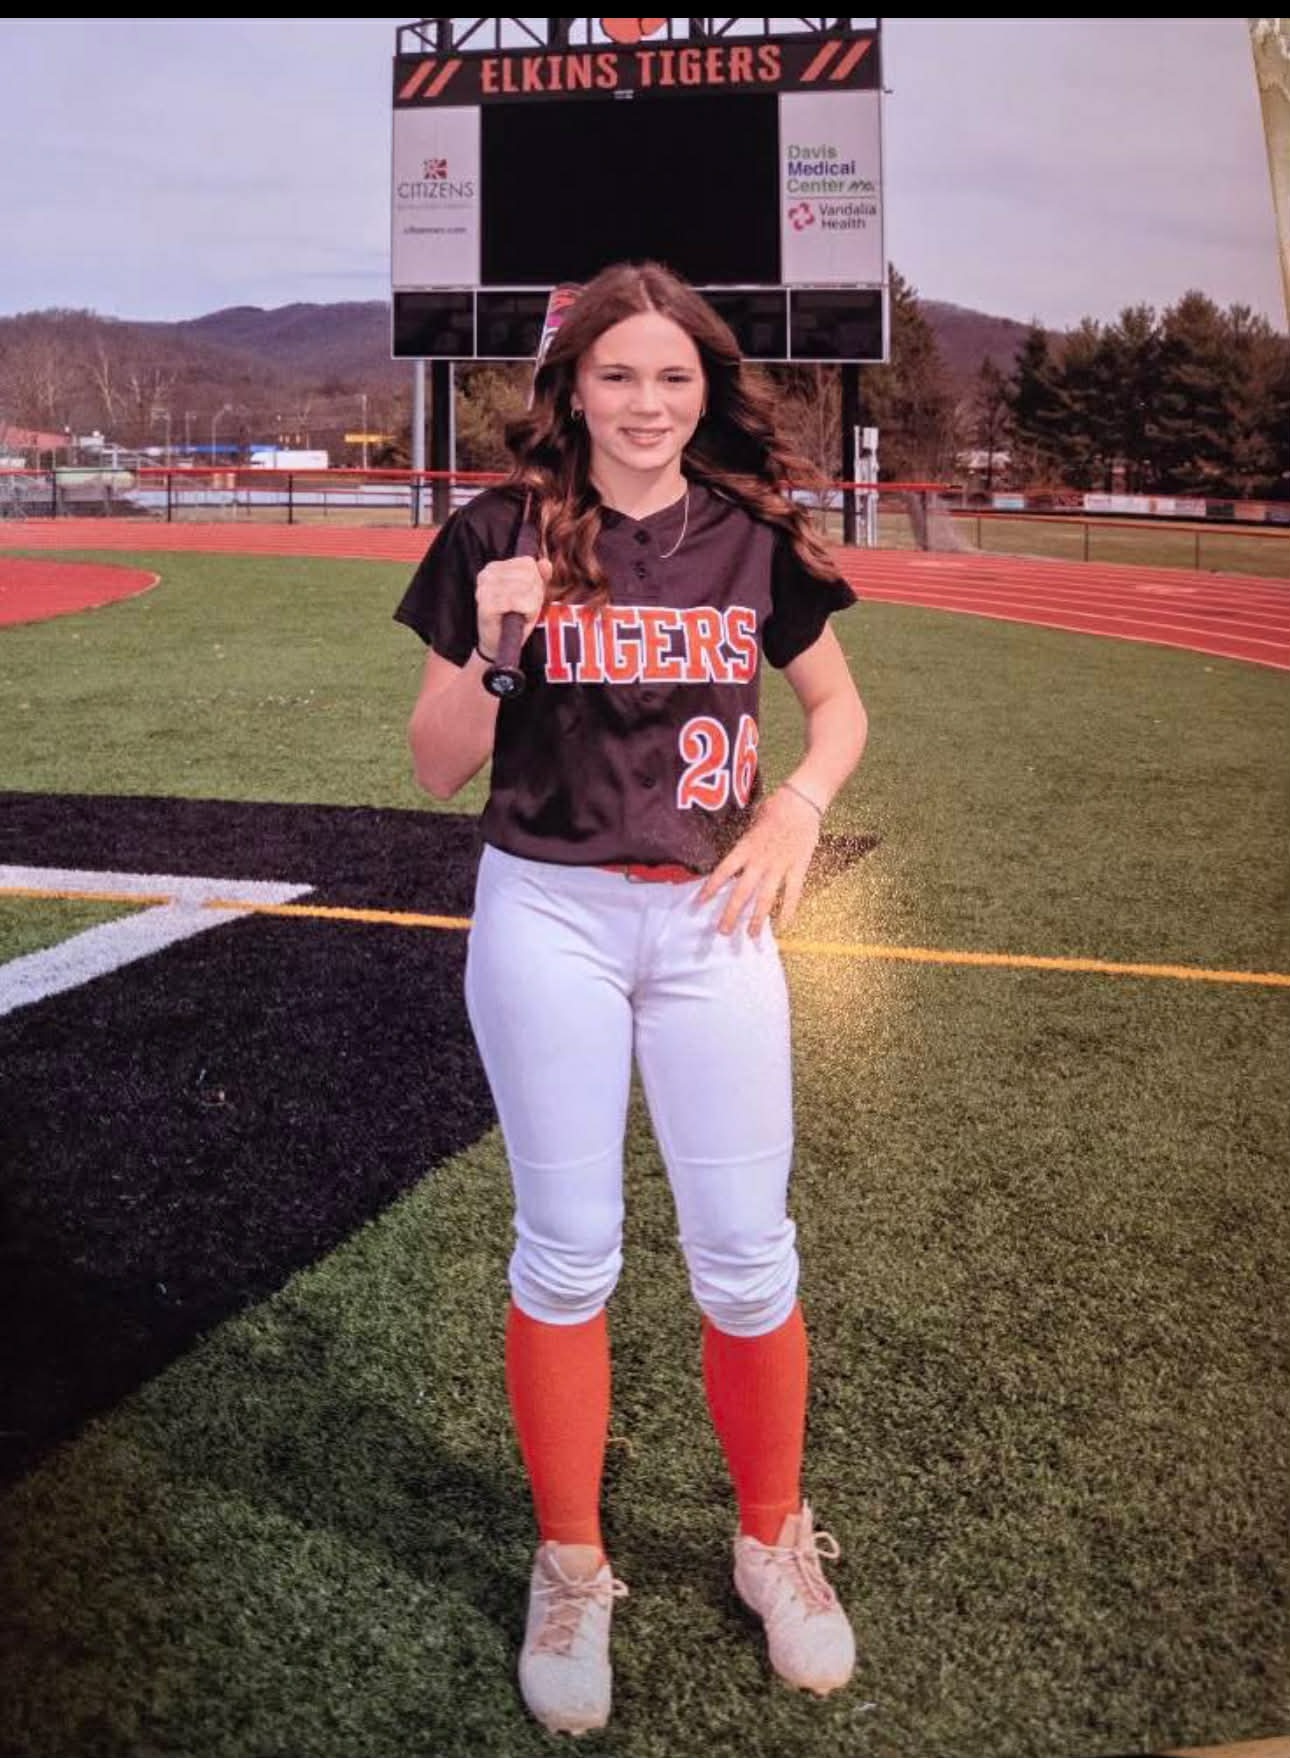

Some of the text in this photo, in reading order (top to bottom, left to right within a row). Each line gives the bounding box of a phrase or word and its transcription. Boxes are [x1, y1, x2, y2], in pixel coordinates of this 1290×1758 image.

[481, 45, 782, 93] ELKINS TIGERS
[787, 144, 838, 159] Davis
[787, 160, 856, 176] Medical
[397, 181, 475, 200] CITIZENS
[786, 178, 844, 193] Center
[819, 202, 877, 216] Vandalia
[821, 218, 867, 230] Health
[535, 601, 758, 684] TIGERS
[677, 714, 759, 811] 26
